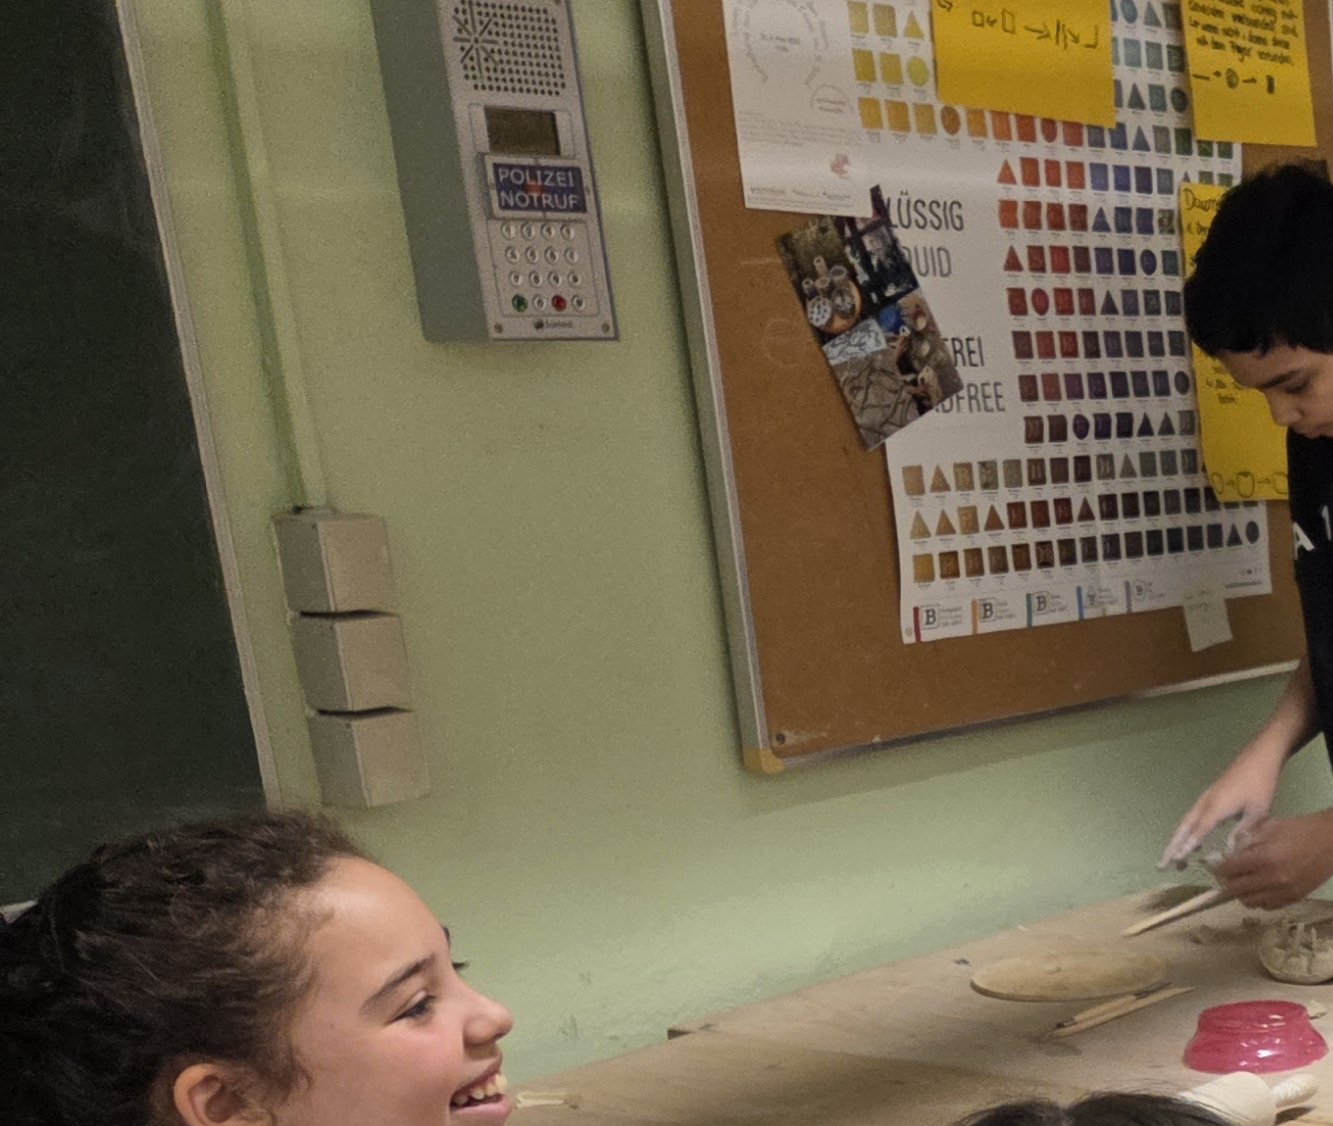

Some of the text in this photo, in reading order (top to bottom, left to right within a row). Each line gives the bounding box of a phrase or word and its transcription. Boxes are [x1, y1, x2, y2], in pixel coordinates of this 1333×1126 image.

[498, 168, 575, 188] POLIZEI
[500, 190, 579, 210] NOTRUF
[886, 189, 964, 231] LÜSSIG
[941, 336, 985, 368] REI
